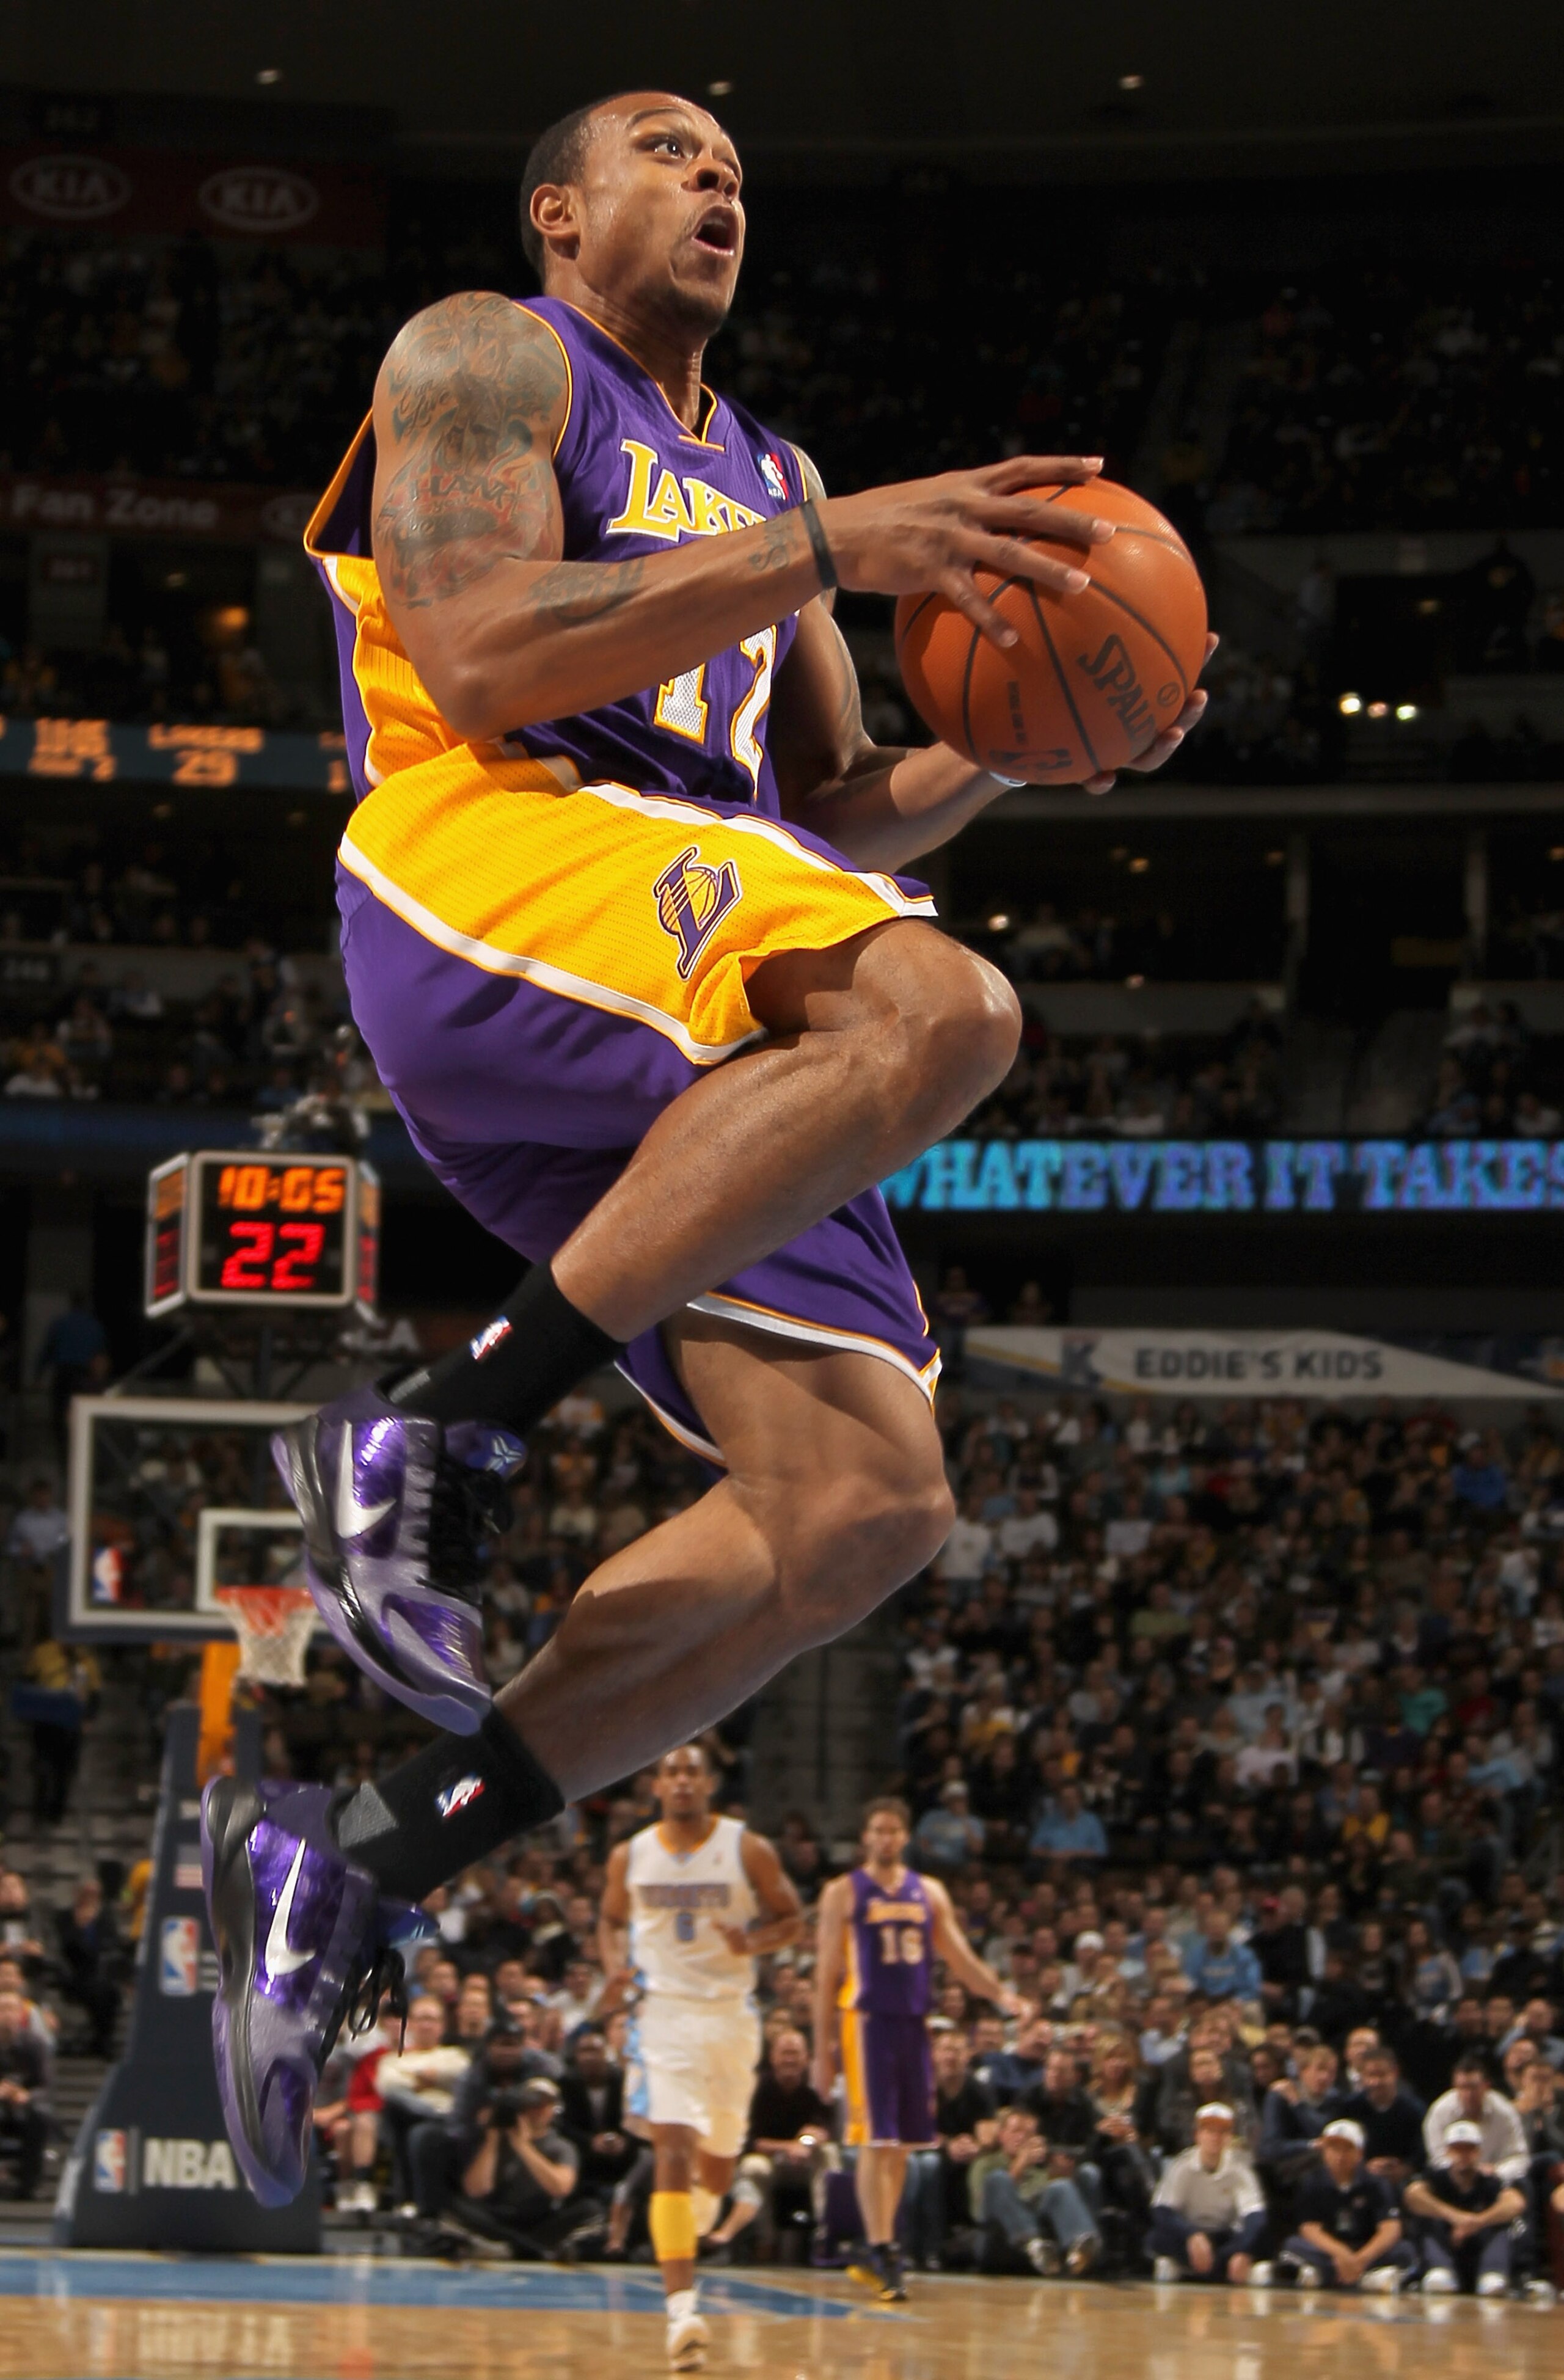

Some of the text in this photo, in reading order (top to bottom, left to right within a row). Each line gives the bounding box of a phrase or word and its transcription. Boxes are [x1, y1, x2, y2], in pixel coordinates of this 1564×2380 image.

[32, 171, 109, 205] KIA
[221, 184, 299, 216] KIA
[11, 485, 216, 529] Fan Zone
[606, 438, 767, 542] LAKE
[1265, 1140, 1345, 1210] IT
[221, 1221, 326, 1291] 22
[1135, 1348, 1383, 1380] EDDIE'S KIDS
[144, 2139, 238, 2191] NBA
